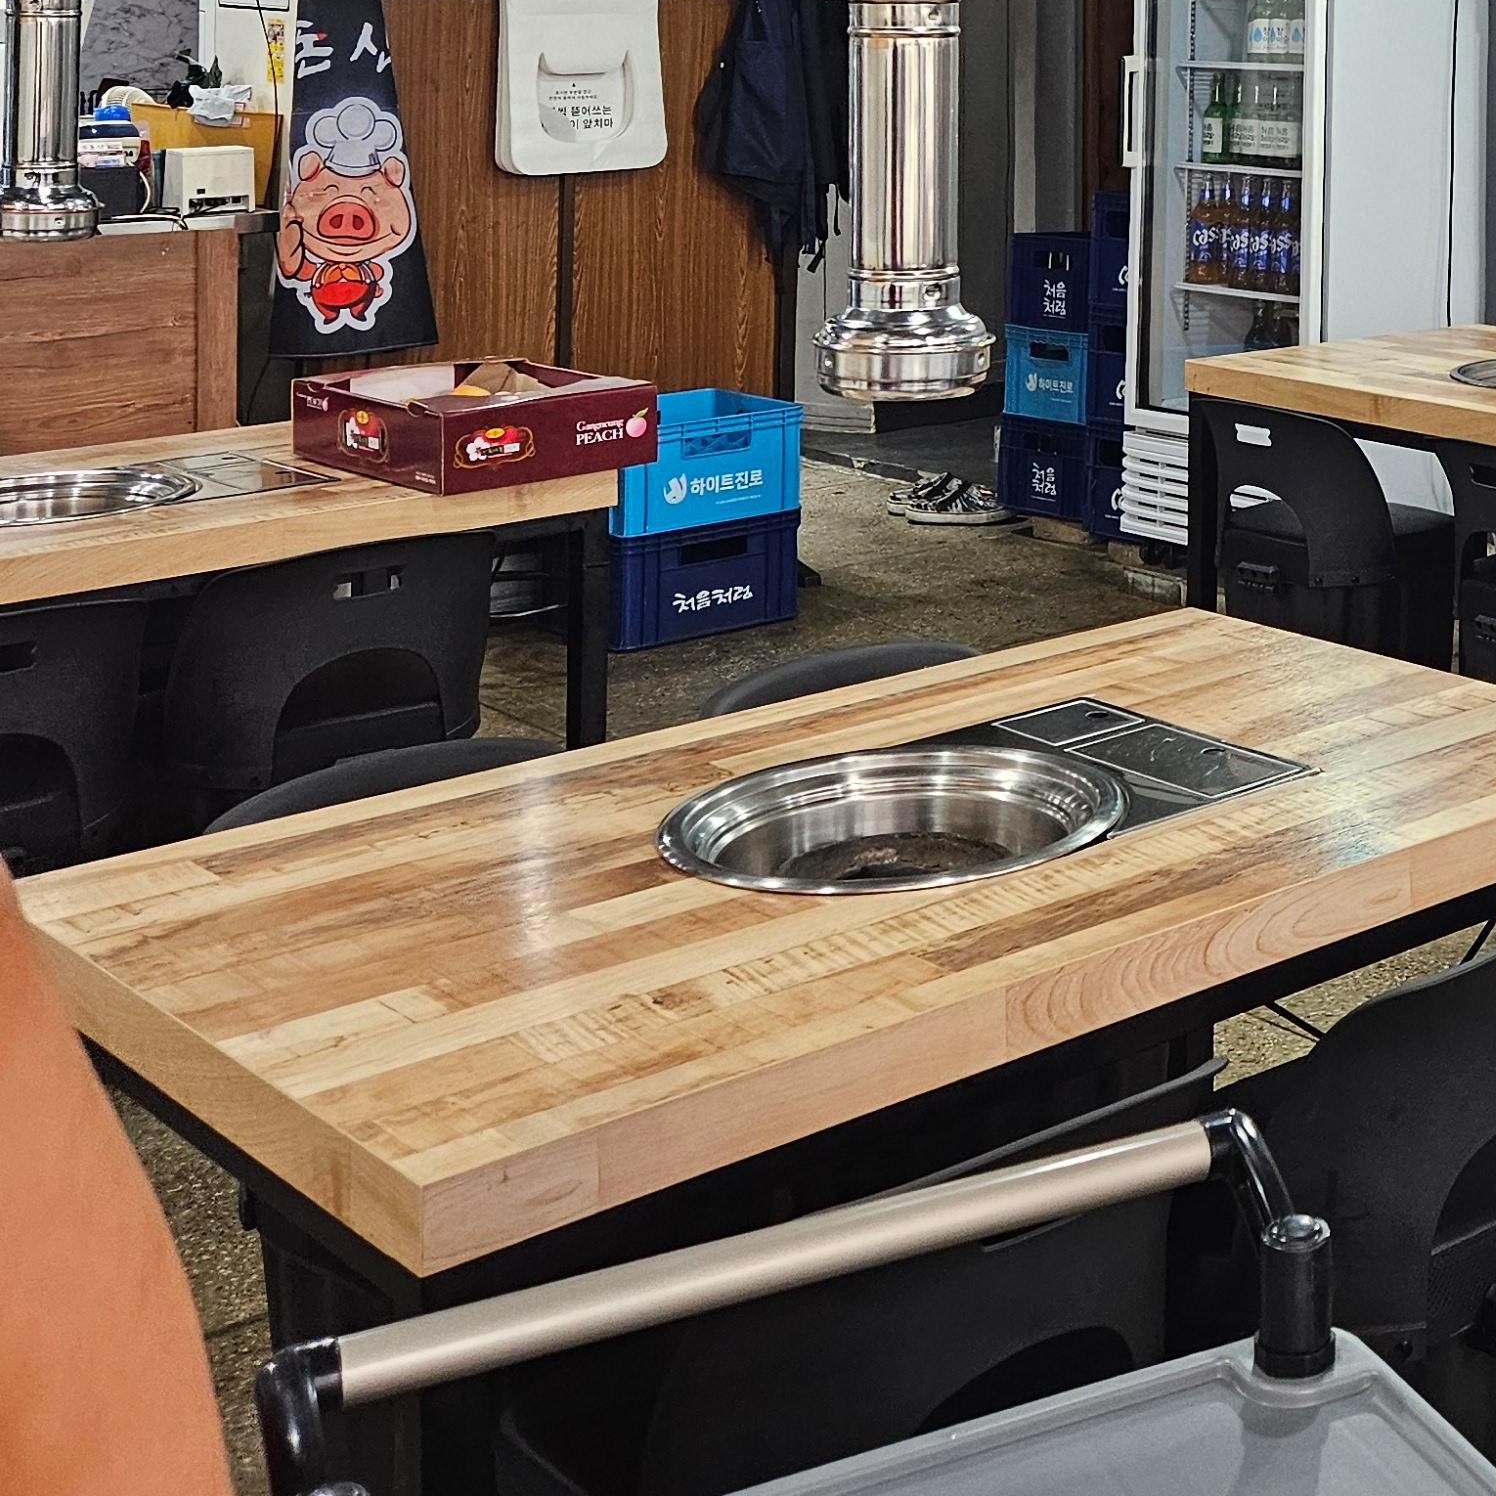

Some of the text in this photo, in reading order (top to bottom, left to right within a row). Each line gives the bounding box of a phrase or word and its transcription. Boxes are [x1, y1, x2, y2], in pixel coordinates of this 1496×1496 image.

[571, 105, 611, 116] 뜯어쓰는
[583, 118, 613, 129] 앞치마
[1043, 279, 1067, 298] 처음
[1043, 297, 1067, 315] 처럼
[576, 428, 624, 445] PEACH
[690, 469, 763, 495] 하이트진로
[672, 585, 753, 613] 처음처럼
